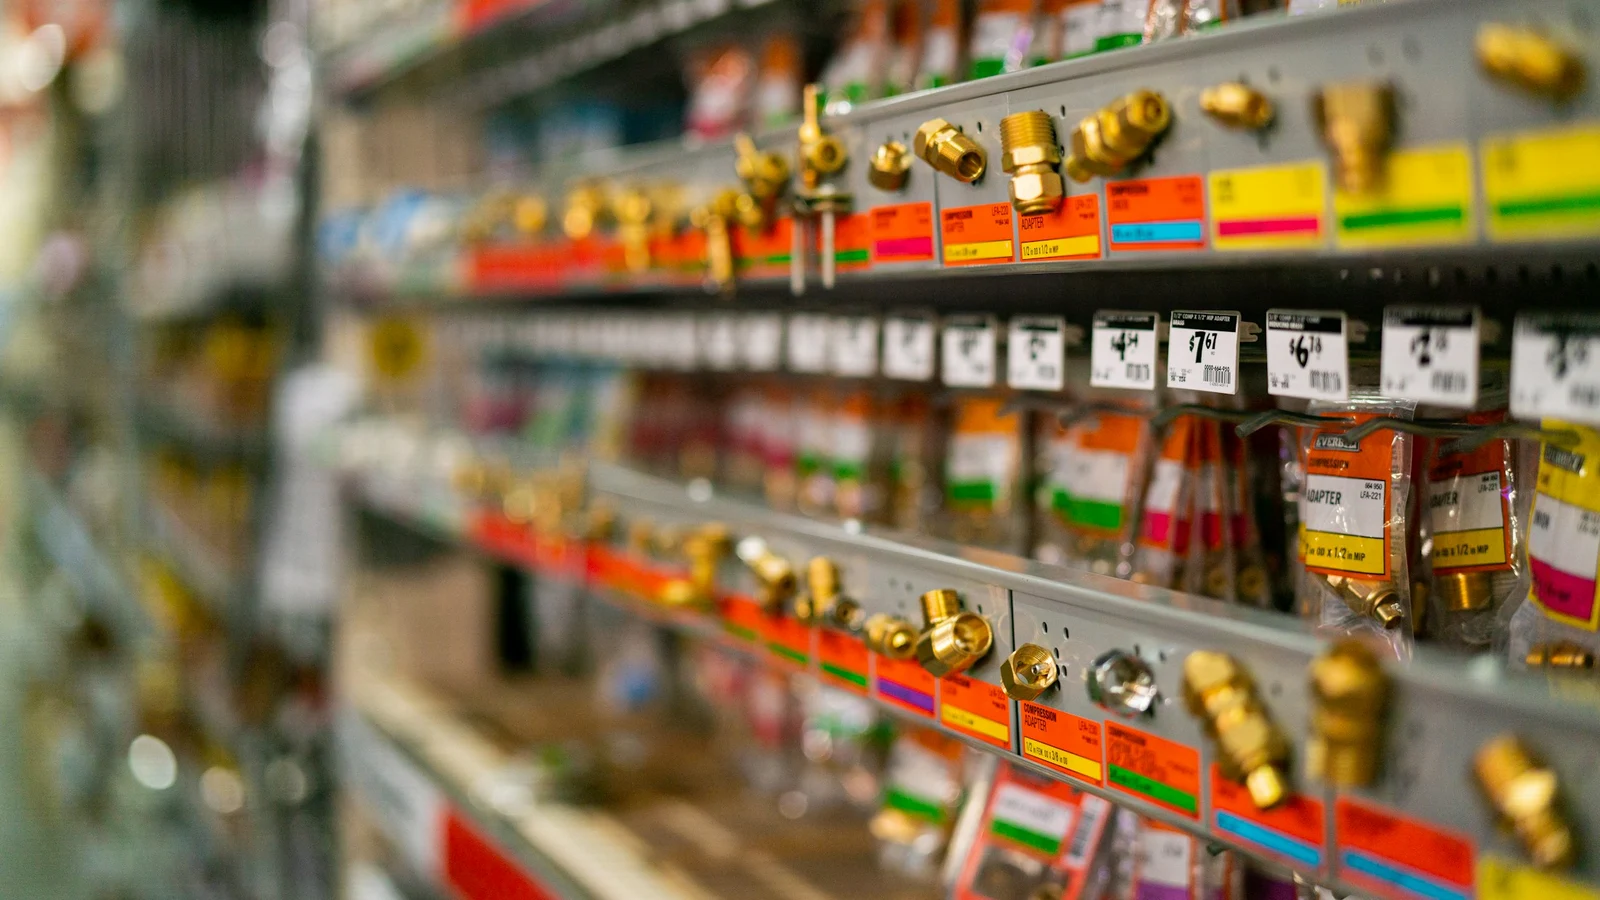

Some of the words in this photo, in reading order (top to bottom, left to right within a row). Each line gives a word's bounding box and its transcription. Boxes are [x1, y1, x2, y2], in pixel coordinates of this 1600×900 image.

[1021, 216, 1045, 230] ADAPTER
[1360, 490, 1381, 500] LFA-221
[1353, 551, 1366, 561] MIP
[1024, 703, 1057, 722] COMPRESSION
[1024, 714, 1048, 732] ADAPTER
